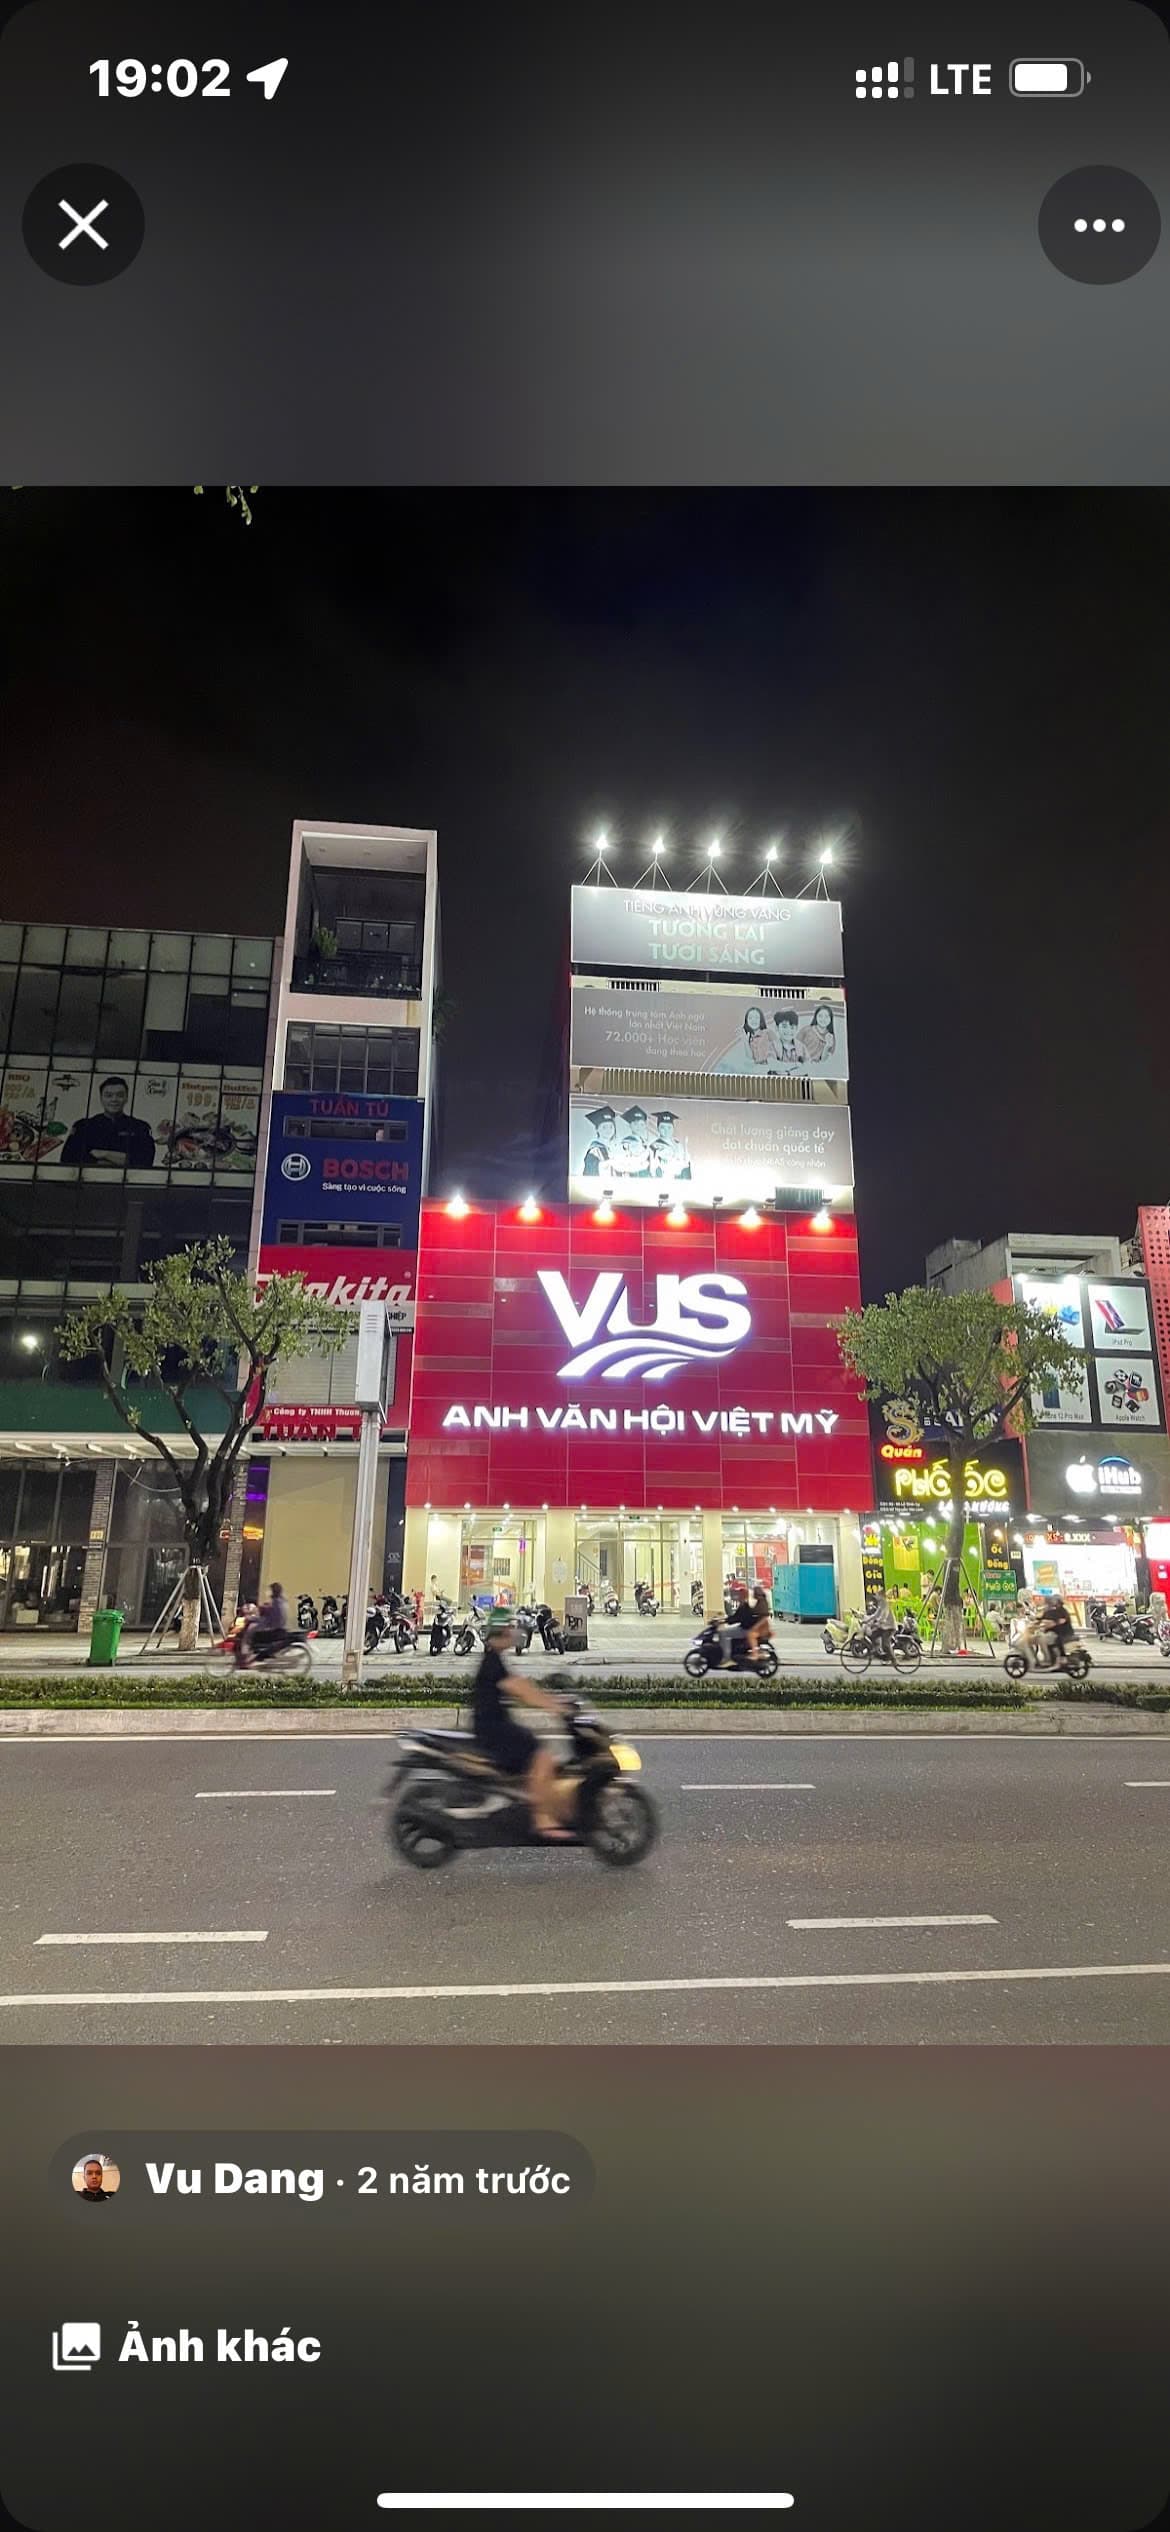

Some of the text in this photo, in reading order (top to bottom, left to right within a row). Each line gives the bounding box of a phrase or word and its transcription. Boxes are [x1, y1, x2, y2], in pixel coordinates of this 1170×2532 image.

[812, 1127, 834, 1142] dạy
[783, 1141, 810, 1155] quốc
[323, 1158, 408, 1180] BOSCH
[322, 1182, 342, 1193] Sáng
[344, 1183, 357, 1193] tạo
[367, 1183, 386, 1193] cuộc
[388, 1184, 407, 1194] sống
[537, 1270, 753, 1348] VUS
[274, 1407, 295, 1416] Công
[298, 1408, 306, 1417] ty
[310, 1408, 332, 1416] TNHH
[442, 1403, 839, 1438] ANH VĂN HỘI VIỆT MỸ
[881, 1444, 922, 1459] Quán
[1098, 1465, 1142, 1485] iHub
